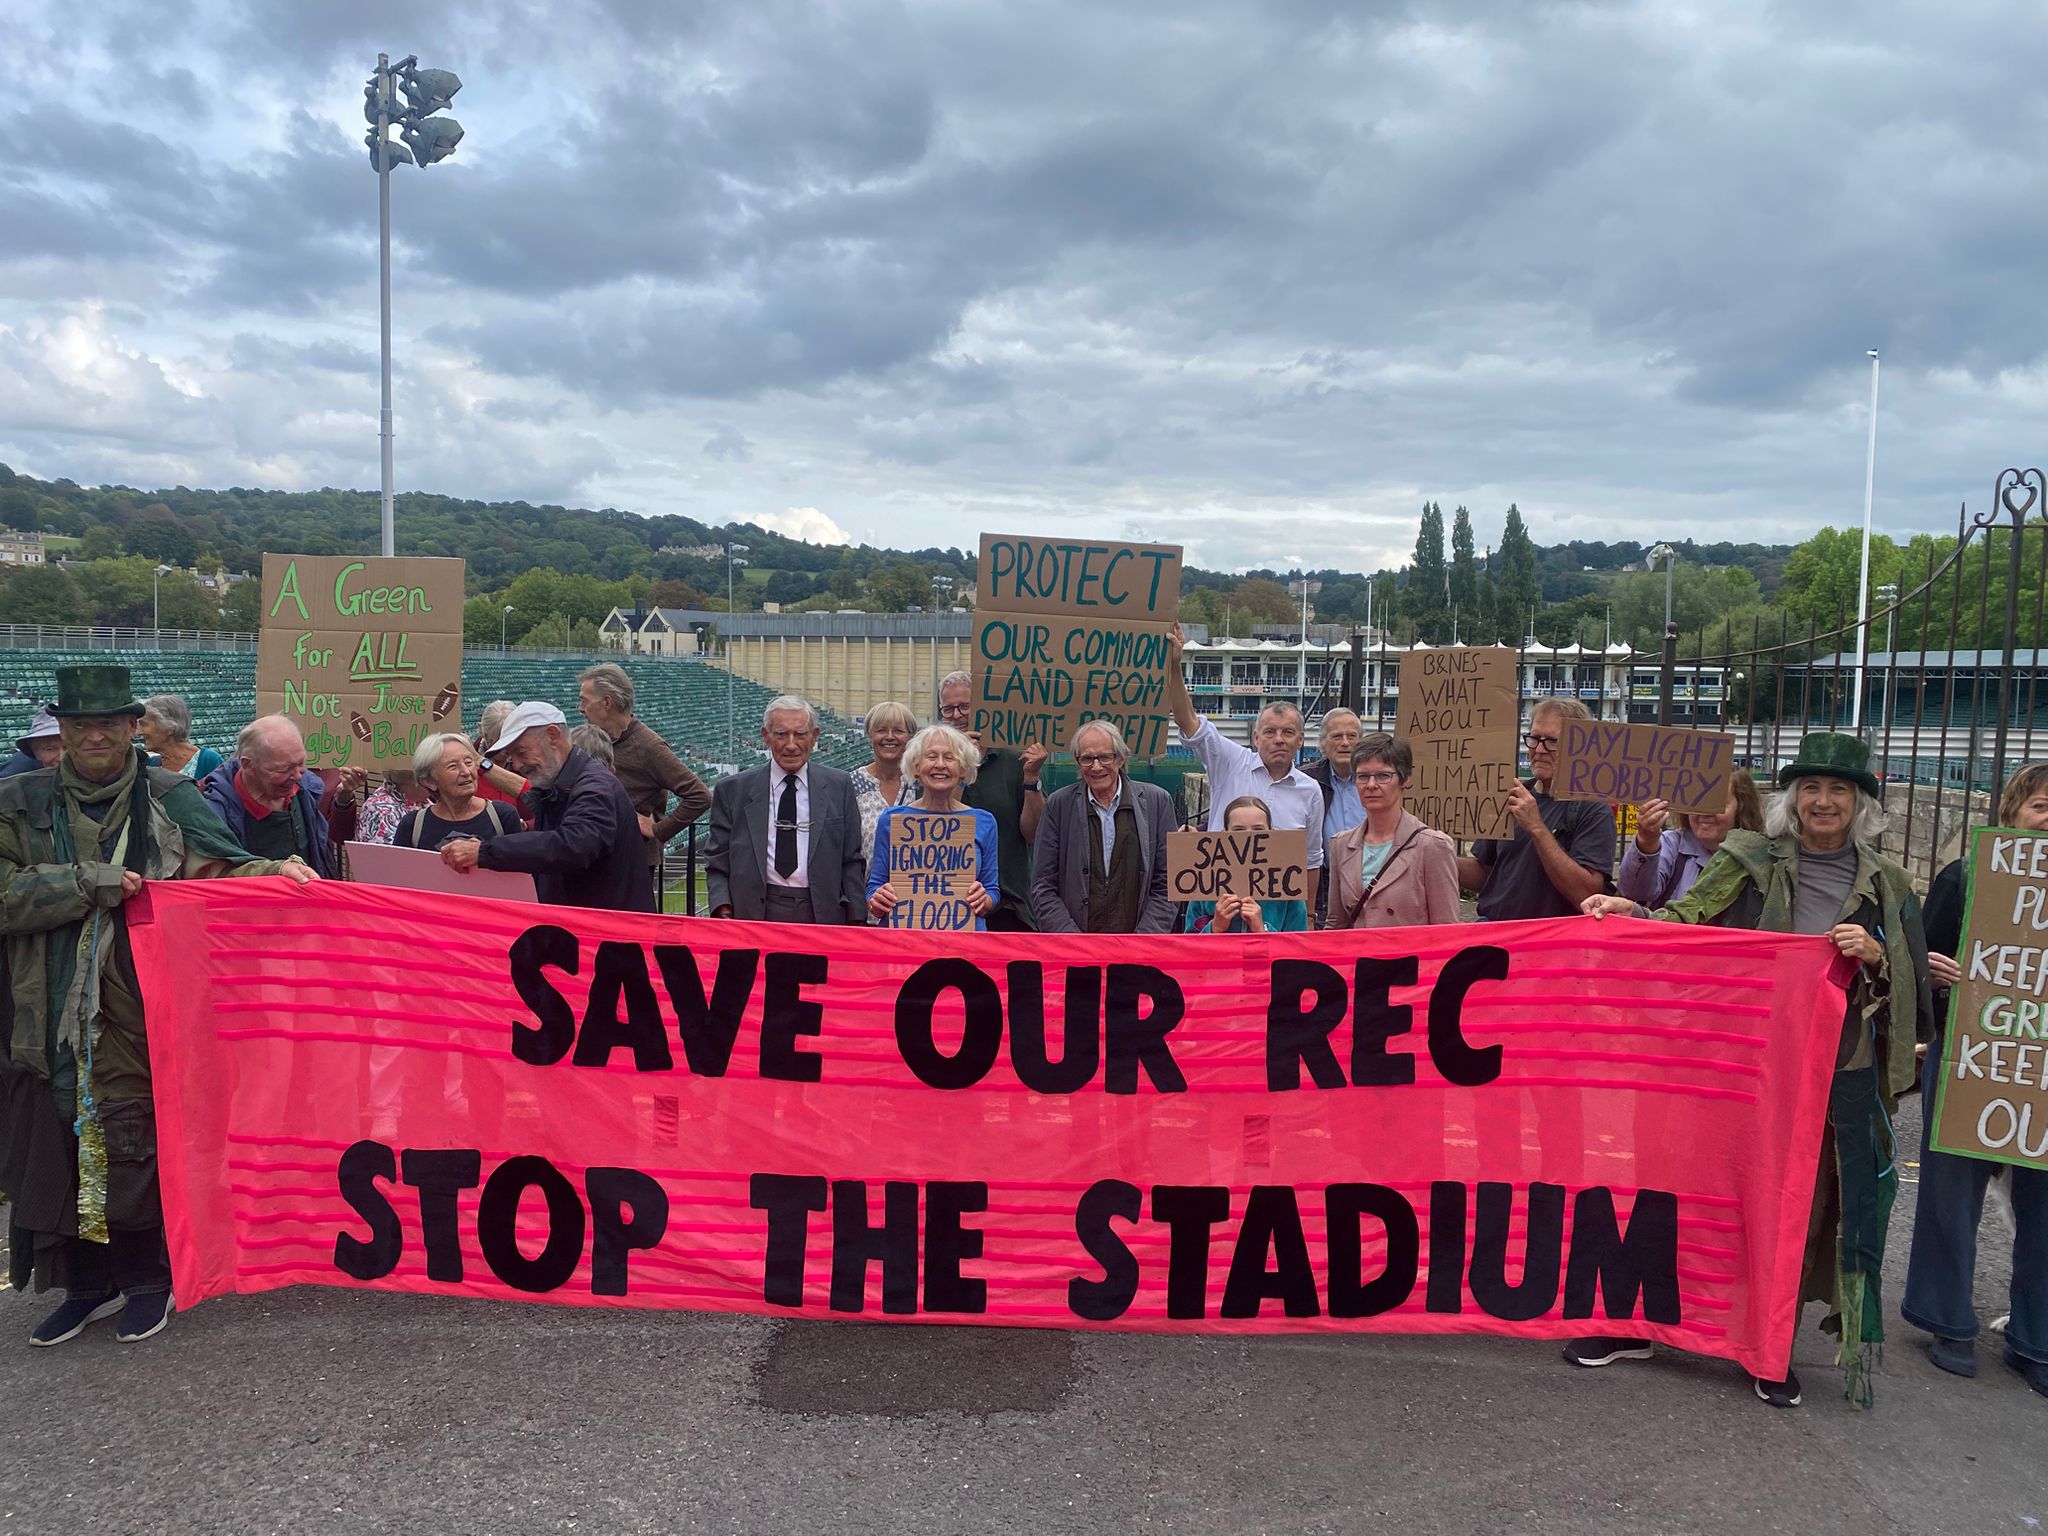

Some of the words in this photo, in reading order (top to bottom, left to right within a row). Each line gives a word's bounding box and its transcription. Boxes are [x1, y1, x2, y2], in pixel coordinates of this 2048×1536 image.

[270, 559, 310, 620] A
[334, 562, 433, 617] Green
[990, 541, 1175, 612] PROTECT
[293, 631, 333, 670] for
[349, 631, 418, 673] ALL
[980, 621, 1054, 664] OUR
[1064, 628, 1169, 670] COMMON
[1423, 652, 1491, 676] B&NES-
[283, 679, 342, 718] Not
[369, 683, 426, 714] Just
[983, 665, 1074, 707] LAND
[1084, 669, 1165, 708] FROM
[1419, 678, 1485, 707] WHAT
[974, 708, 1065, 747] PRIVATE
[1079, 710, 1169, 755] OFIT
[1409, 709, 1491, 735] ABOUT
[303, 722, 352, 768] gby
[1427, 738, 1475, 761] THE
[1568, 724, 1731, 769] DAYLIGHT
[1569, 759, 1723, 807] ROBBERY
[900, 816, 960, 842] STOP
[891, 843, 974, 872] IGNORING
[1194, 833, 1270, 869] SAVE
[908, 873, 957, 896] THE
[1175, 868, 1235, 897] OUR
[1248, 865, 1303, 898] REC
[890, 899, 971, 930] FLOOD
[509, 925, 829, 1083] SAVE
[894, 957, 1188, 1094] OUR
[1266, 945, 1510, 1093] REC
[333, 1139, 669, 1296] STOP
[750, 1172, 988, 1315] THE
[1067, 1178, 1682, 1325] STADIUM
